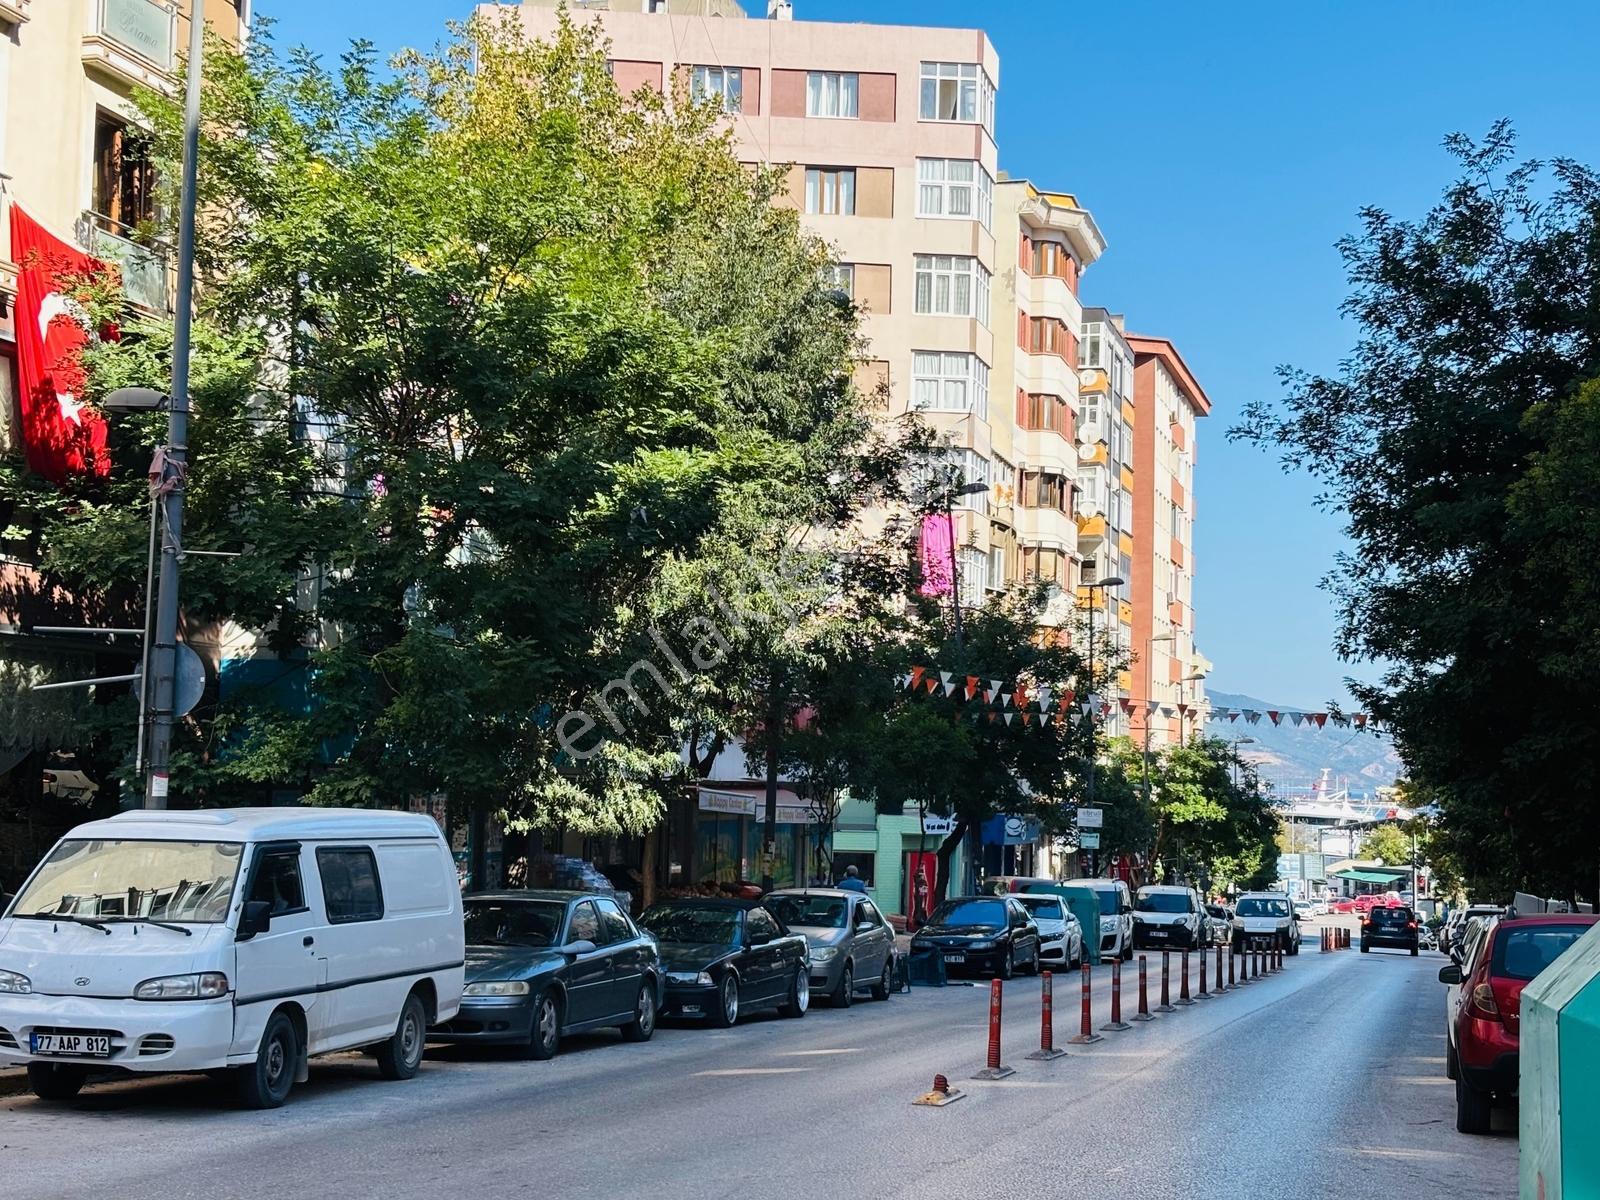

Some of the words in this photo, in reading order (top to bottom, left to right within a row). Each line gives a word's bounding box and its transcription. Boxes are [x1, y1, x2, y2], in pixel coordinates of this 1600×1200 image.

[37, 1035, 53, 1050] 77
[58, 1036, 81, 1051] AAP
[86, 1037, 108, 1052] 812
